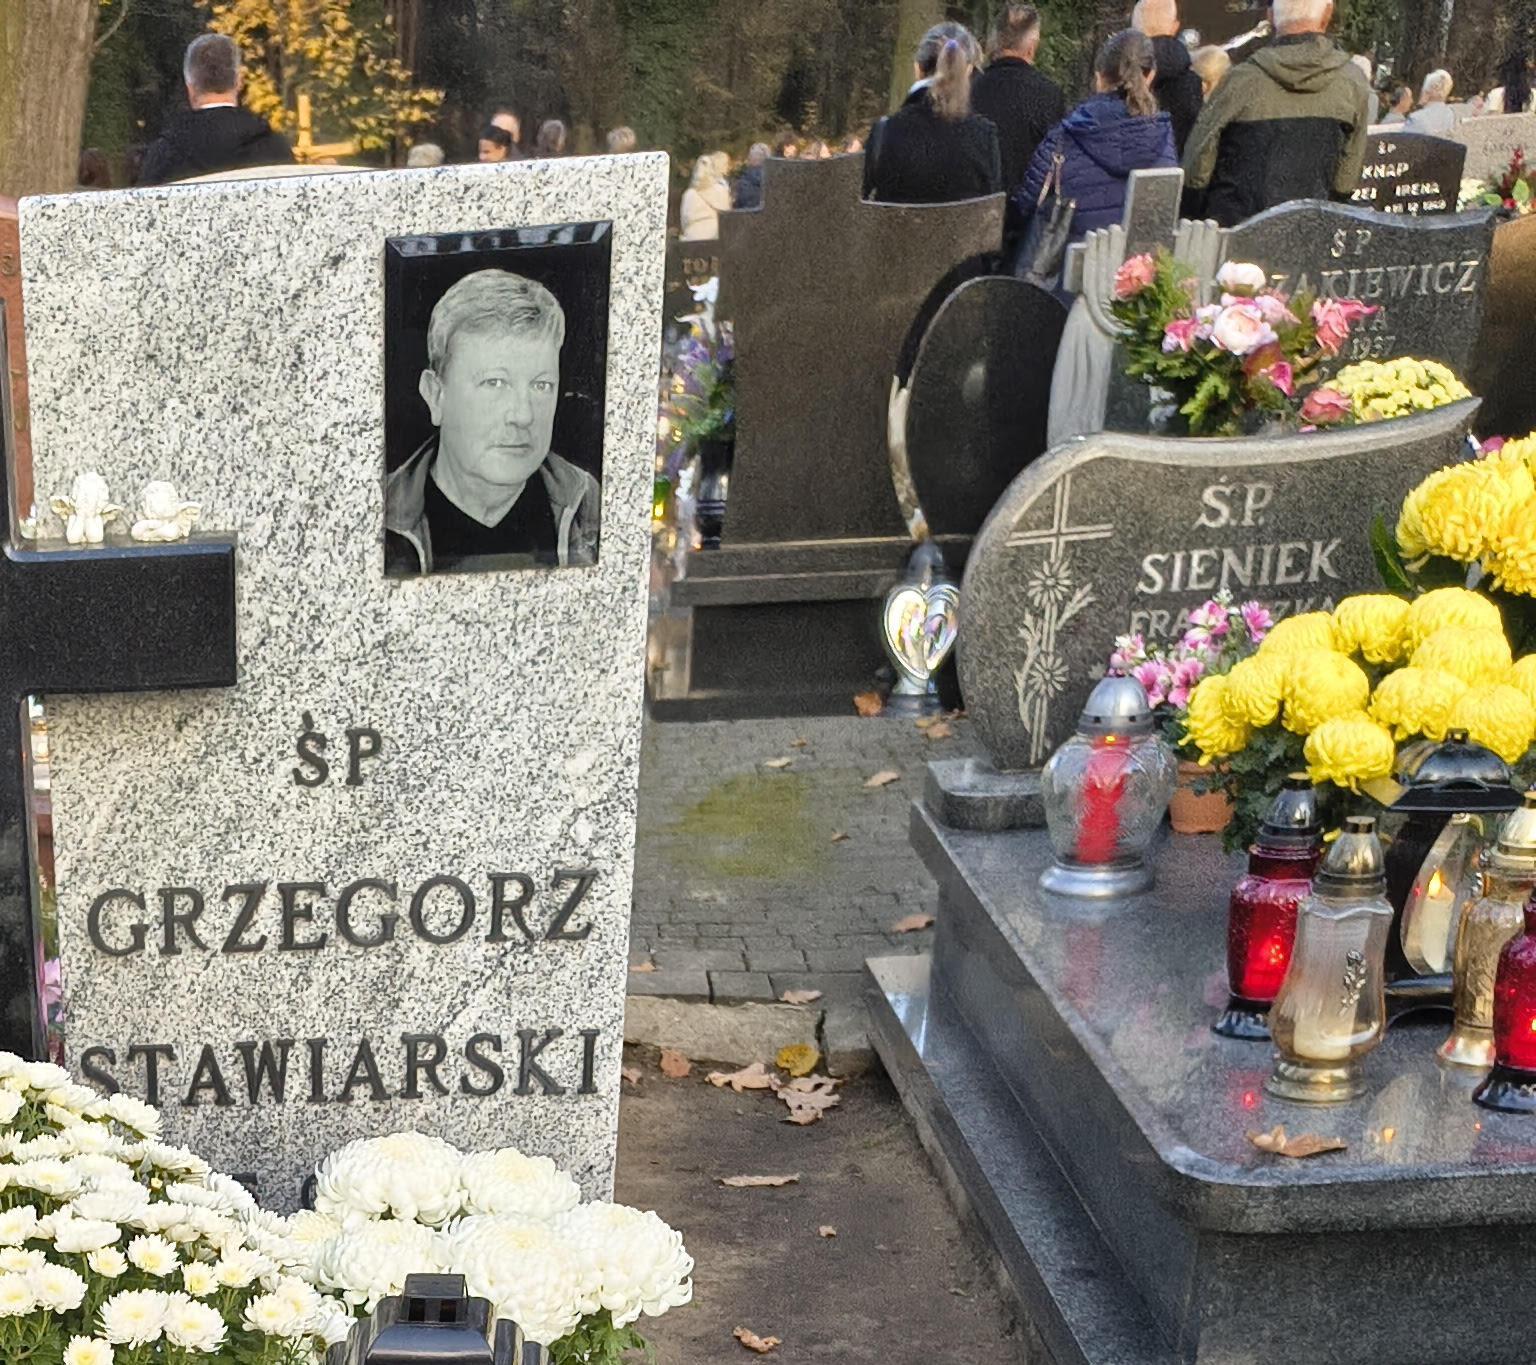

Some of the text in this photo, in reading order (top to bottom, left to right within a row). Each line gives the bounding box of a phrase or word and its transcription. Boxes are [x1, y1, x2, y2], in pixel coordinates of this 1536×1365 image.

[1361, 162, 1410, 180] KNAP
[1395, 182, 1440, 197] IRENA
[1135, 537, 1342, 594] SIENIEK
[86, 868, 600, 957] GRZEGORZ
[80, 1027, 601, 1106] STAWIARSKI
